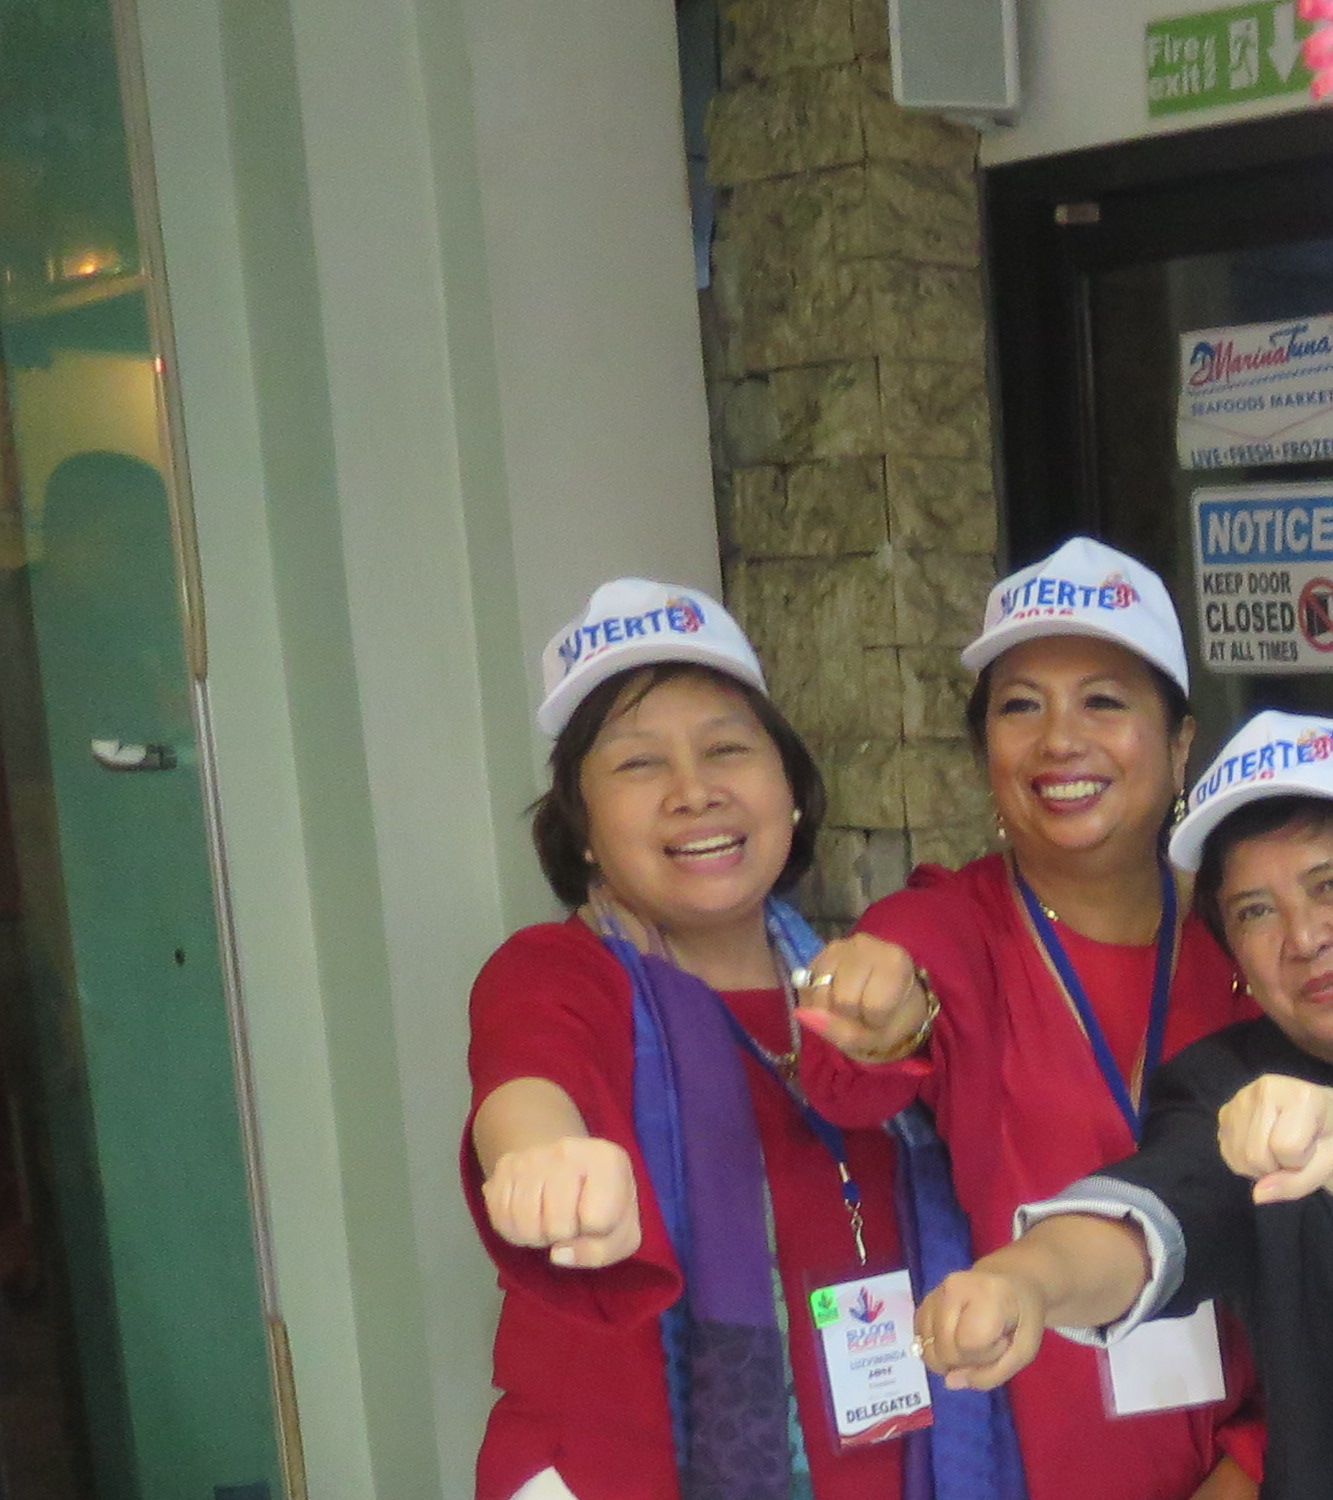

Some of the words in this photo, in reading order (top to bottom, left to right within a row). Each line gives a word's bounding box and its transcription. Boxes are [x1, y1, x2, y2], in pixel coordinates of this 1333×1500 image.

[1192, 395, 1265, 416] SEAFOODS
[1202, 571, 1243, 595] KEEP
[1248, 571, 1292, 595] DOOR
[1205, 601, 1295, 633] CLOSED
[1208, 641, 1226, 661] AT
[1230, 641, 1255, 661] ALL
[1258, 640, 1298, 662] TIMES
[846, 1391, 922, 1424] DELEGATES
